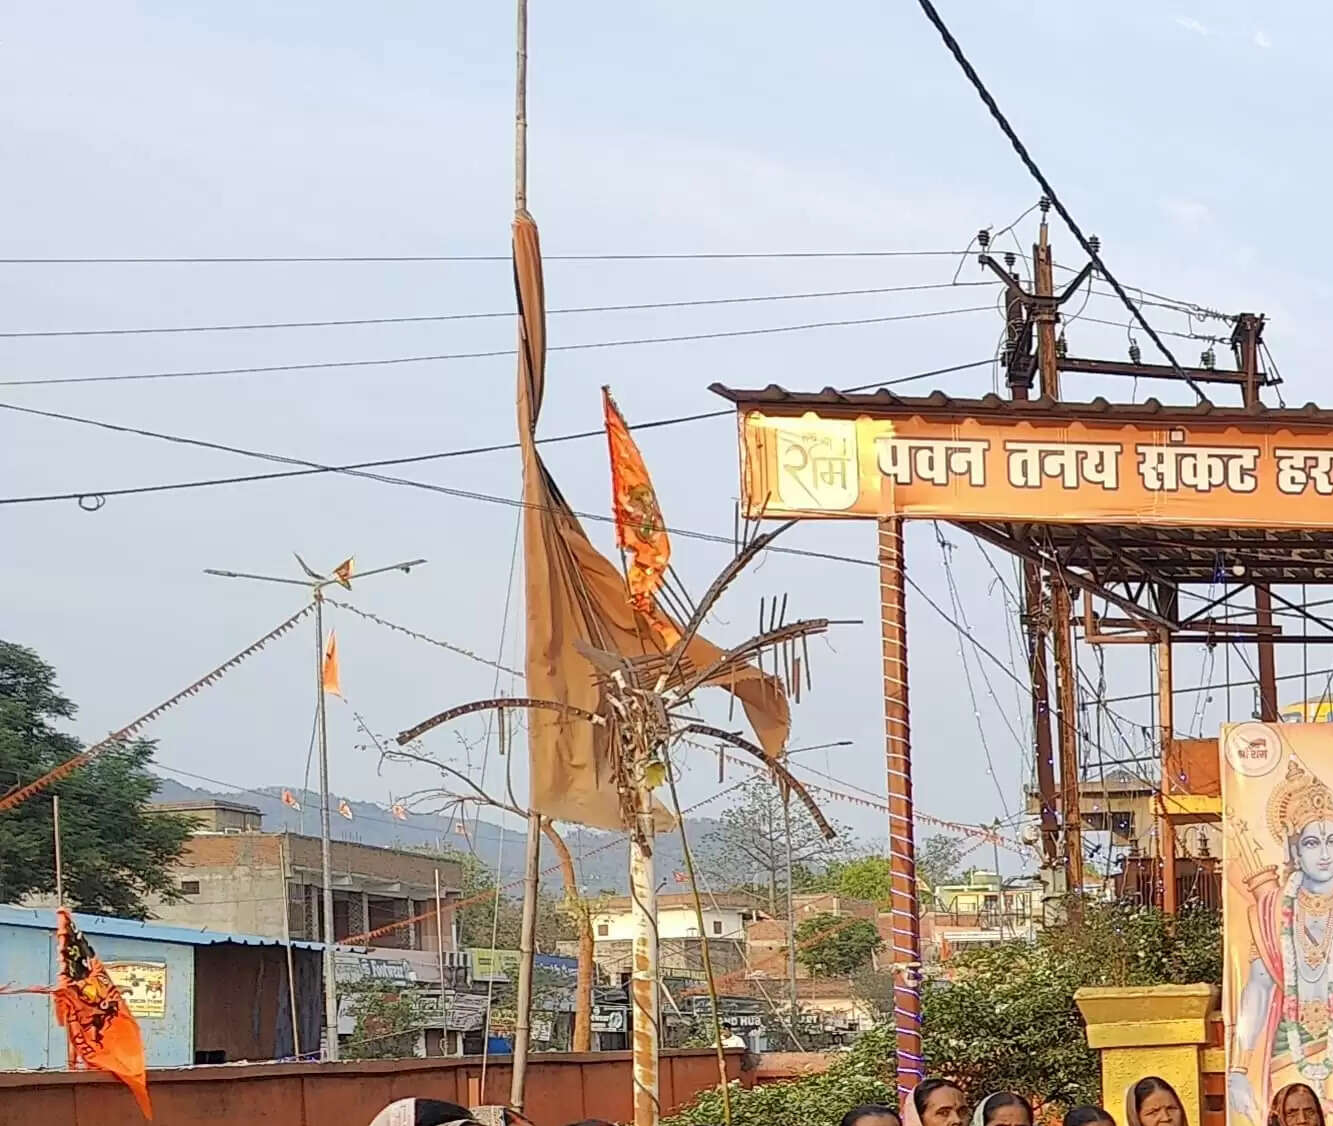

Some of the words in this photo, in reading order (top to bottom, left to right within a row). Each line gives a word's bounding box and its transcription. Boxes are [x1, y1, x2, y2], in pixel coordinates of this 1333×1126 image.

[875, 437, 989, 486] पवन
[1004, 441, 1122, 489] तनय
[1136, 427, 1258, 493] संकट
